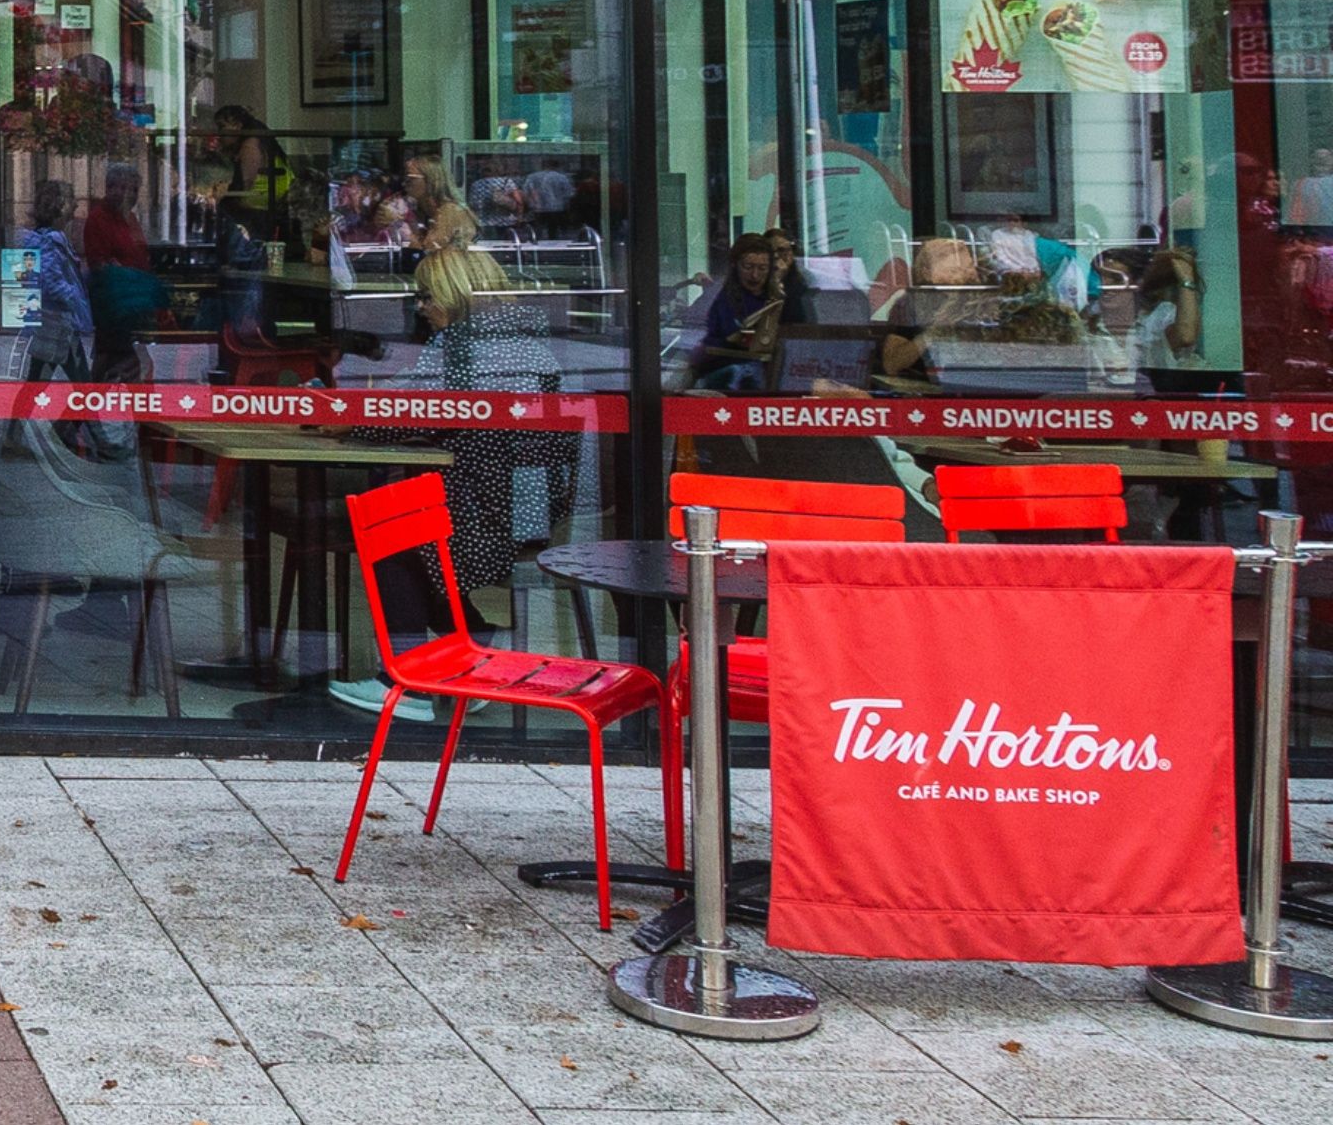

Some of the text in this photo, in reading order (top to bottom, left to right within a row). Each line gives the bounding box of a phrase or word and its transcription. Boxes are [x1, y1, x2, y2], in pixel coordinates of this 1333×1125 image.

[1130, 41, 1160, 51] FROM
[67, 391, 493, 421] COFFEE DONUTS ESPRESSO
[747, 406, 891, 428] BREAKFAST
[942, 408, 1114, 430] SANDWICHES
[1166, 410, 1259, 432] WRAPS
[830, 698, 929, 764] Tim
[898, 781, 1101, 806] CAFÉ AND BAKE SHOP
